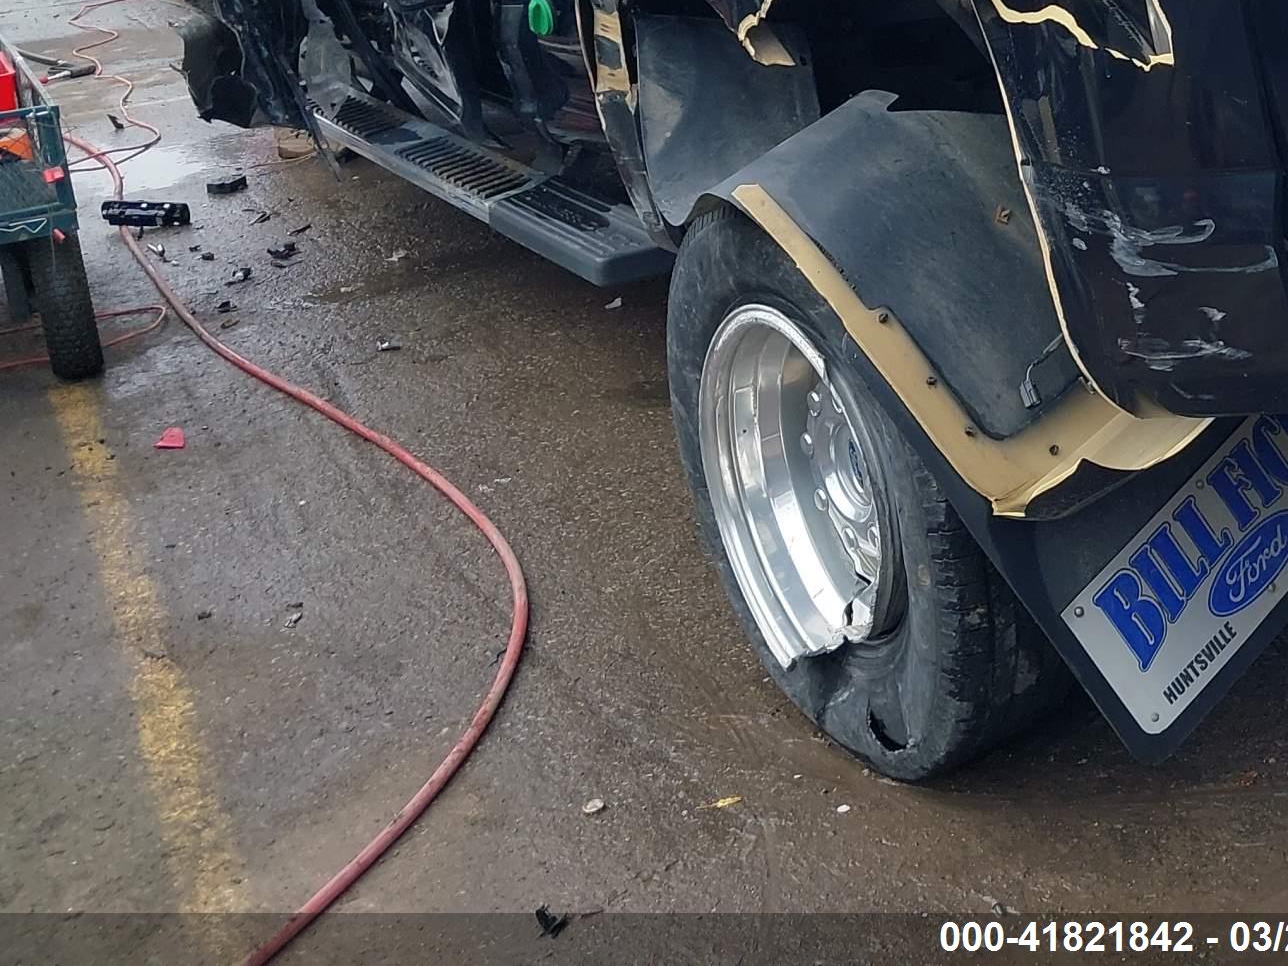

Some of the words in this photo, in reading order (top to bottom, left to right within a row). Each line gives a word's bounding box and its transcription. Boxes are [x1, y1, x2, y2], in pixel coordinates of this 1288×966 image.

[1092, 494, 1235, 673] BILL
[1225, 524, 1288, 604] Ford
[1162, 620, 1238, 706] HUNTSVILLE
